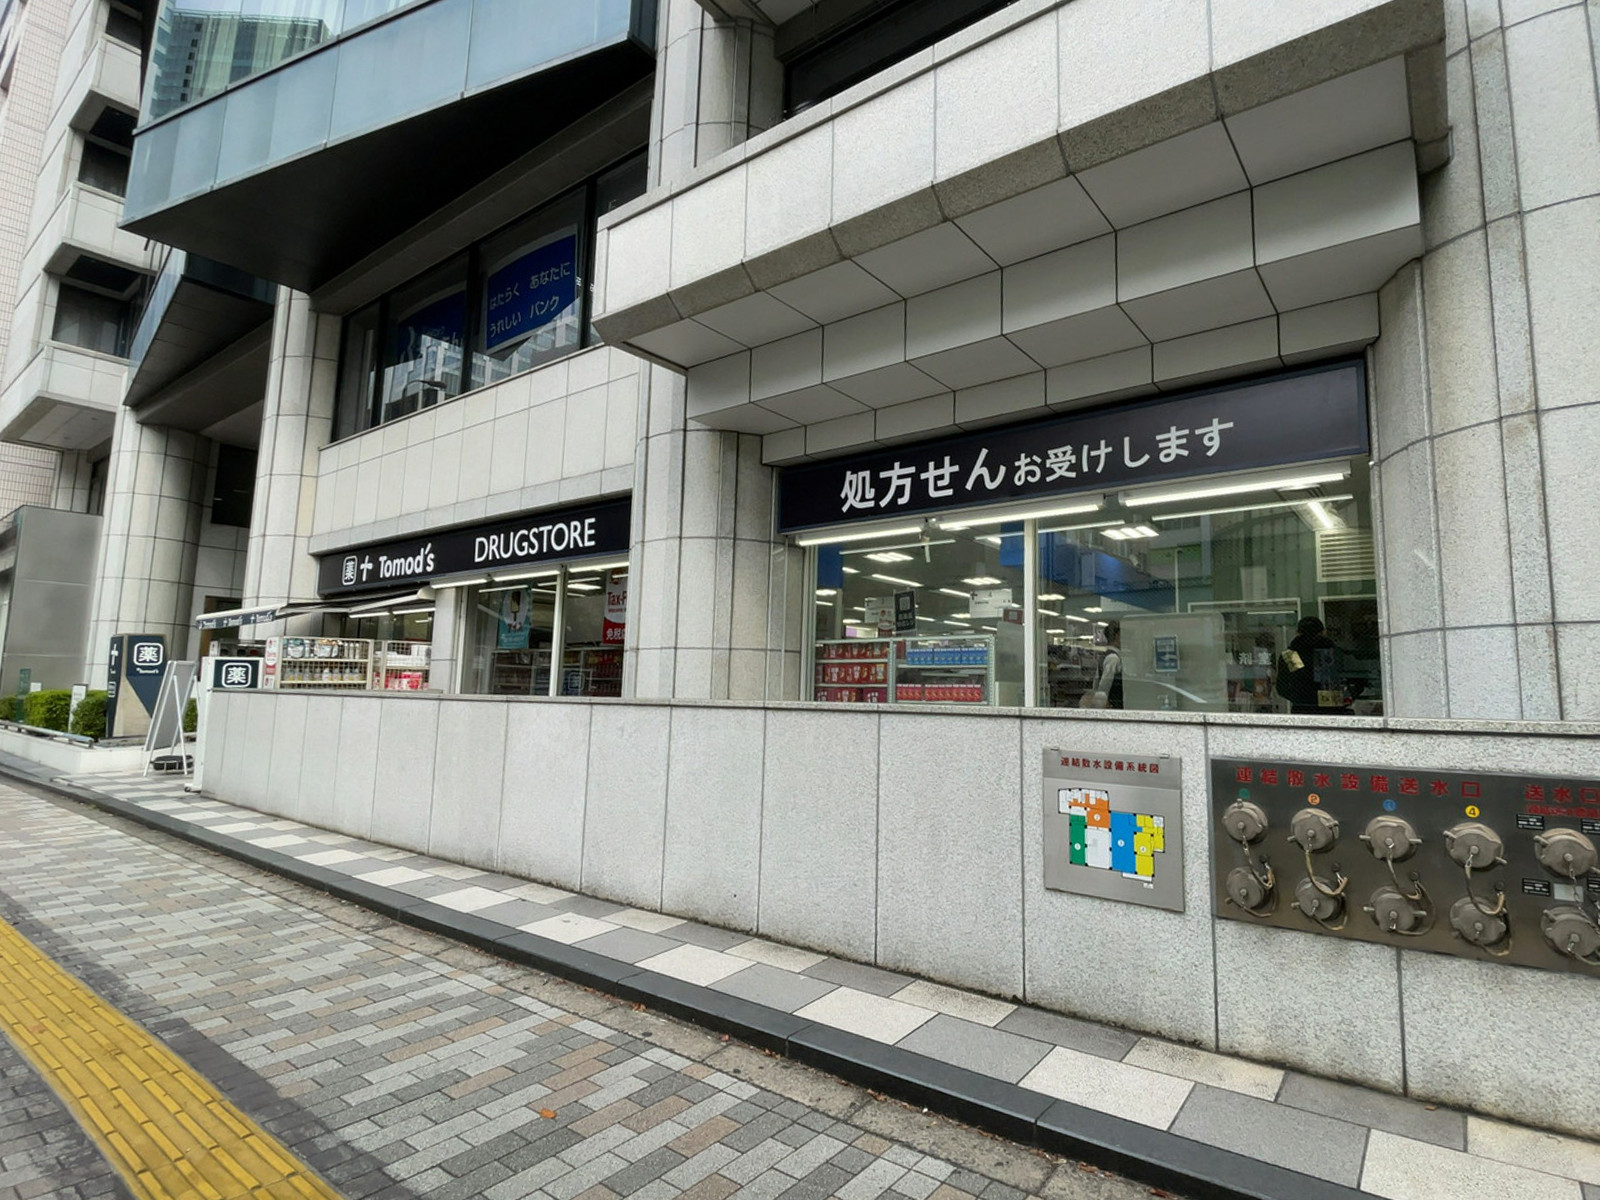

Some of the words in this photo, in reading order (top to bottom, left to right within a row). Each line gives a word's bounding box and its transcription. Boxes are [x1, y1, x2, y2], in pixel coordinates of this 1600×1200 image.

[490, 283, 520, 310] はたらく
[530, 261, 571, 289] あなたに
[490, 312, 521, 337] うれしい
[840, 417, 1234, 512] 処方せんお受けします
[474, 517, 596, 563] DRUGSTORE
[378, 542, 435, 578] Tomod's
[138, 645, 158, 662] 薬
[226, 666, 247, 684] 薬
[1236, 766, 1481, 798] 連結散水設備送水口
[1525, 784, 1600, 804] 送水口
